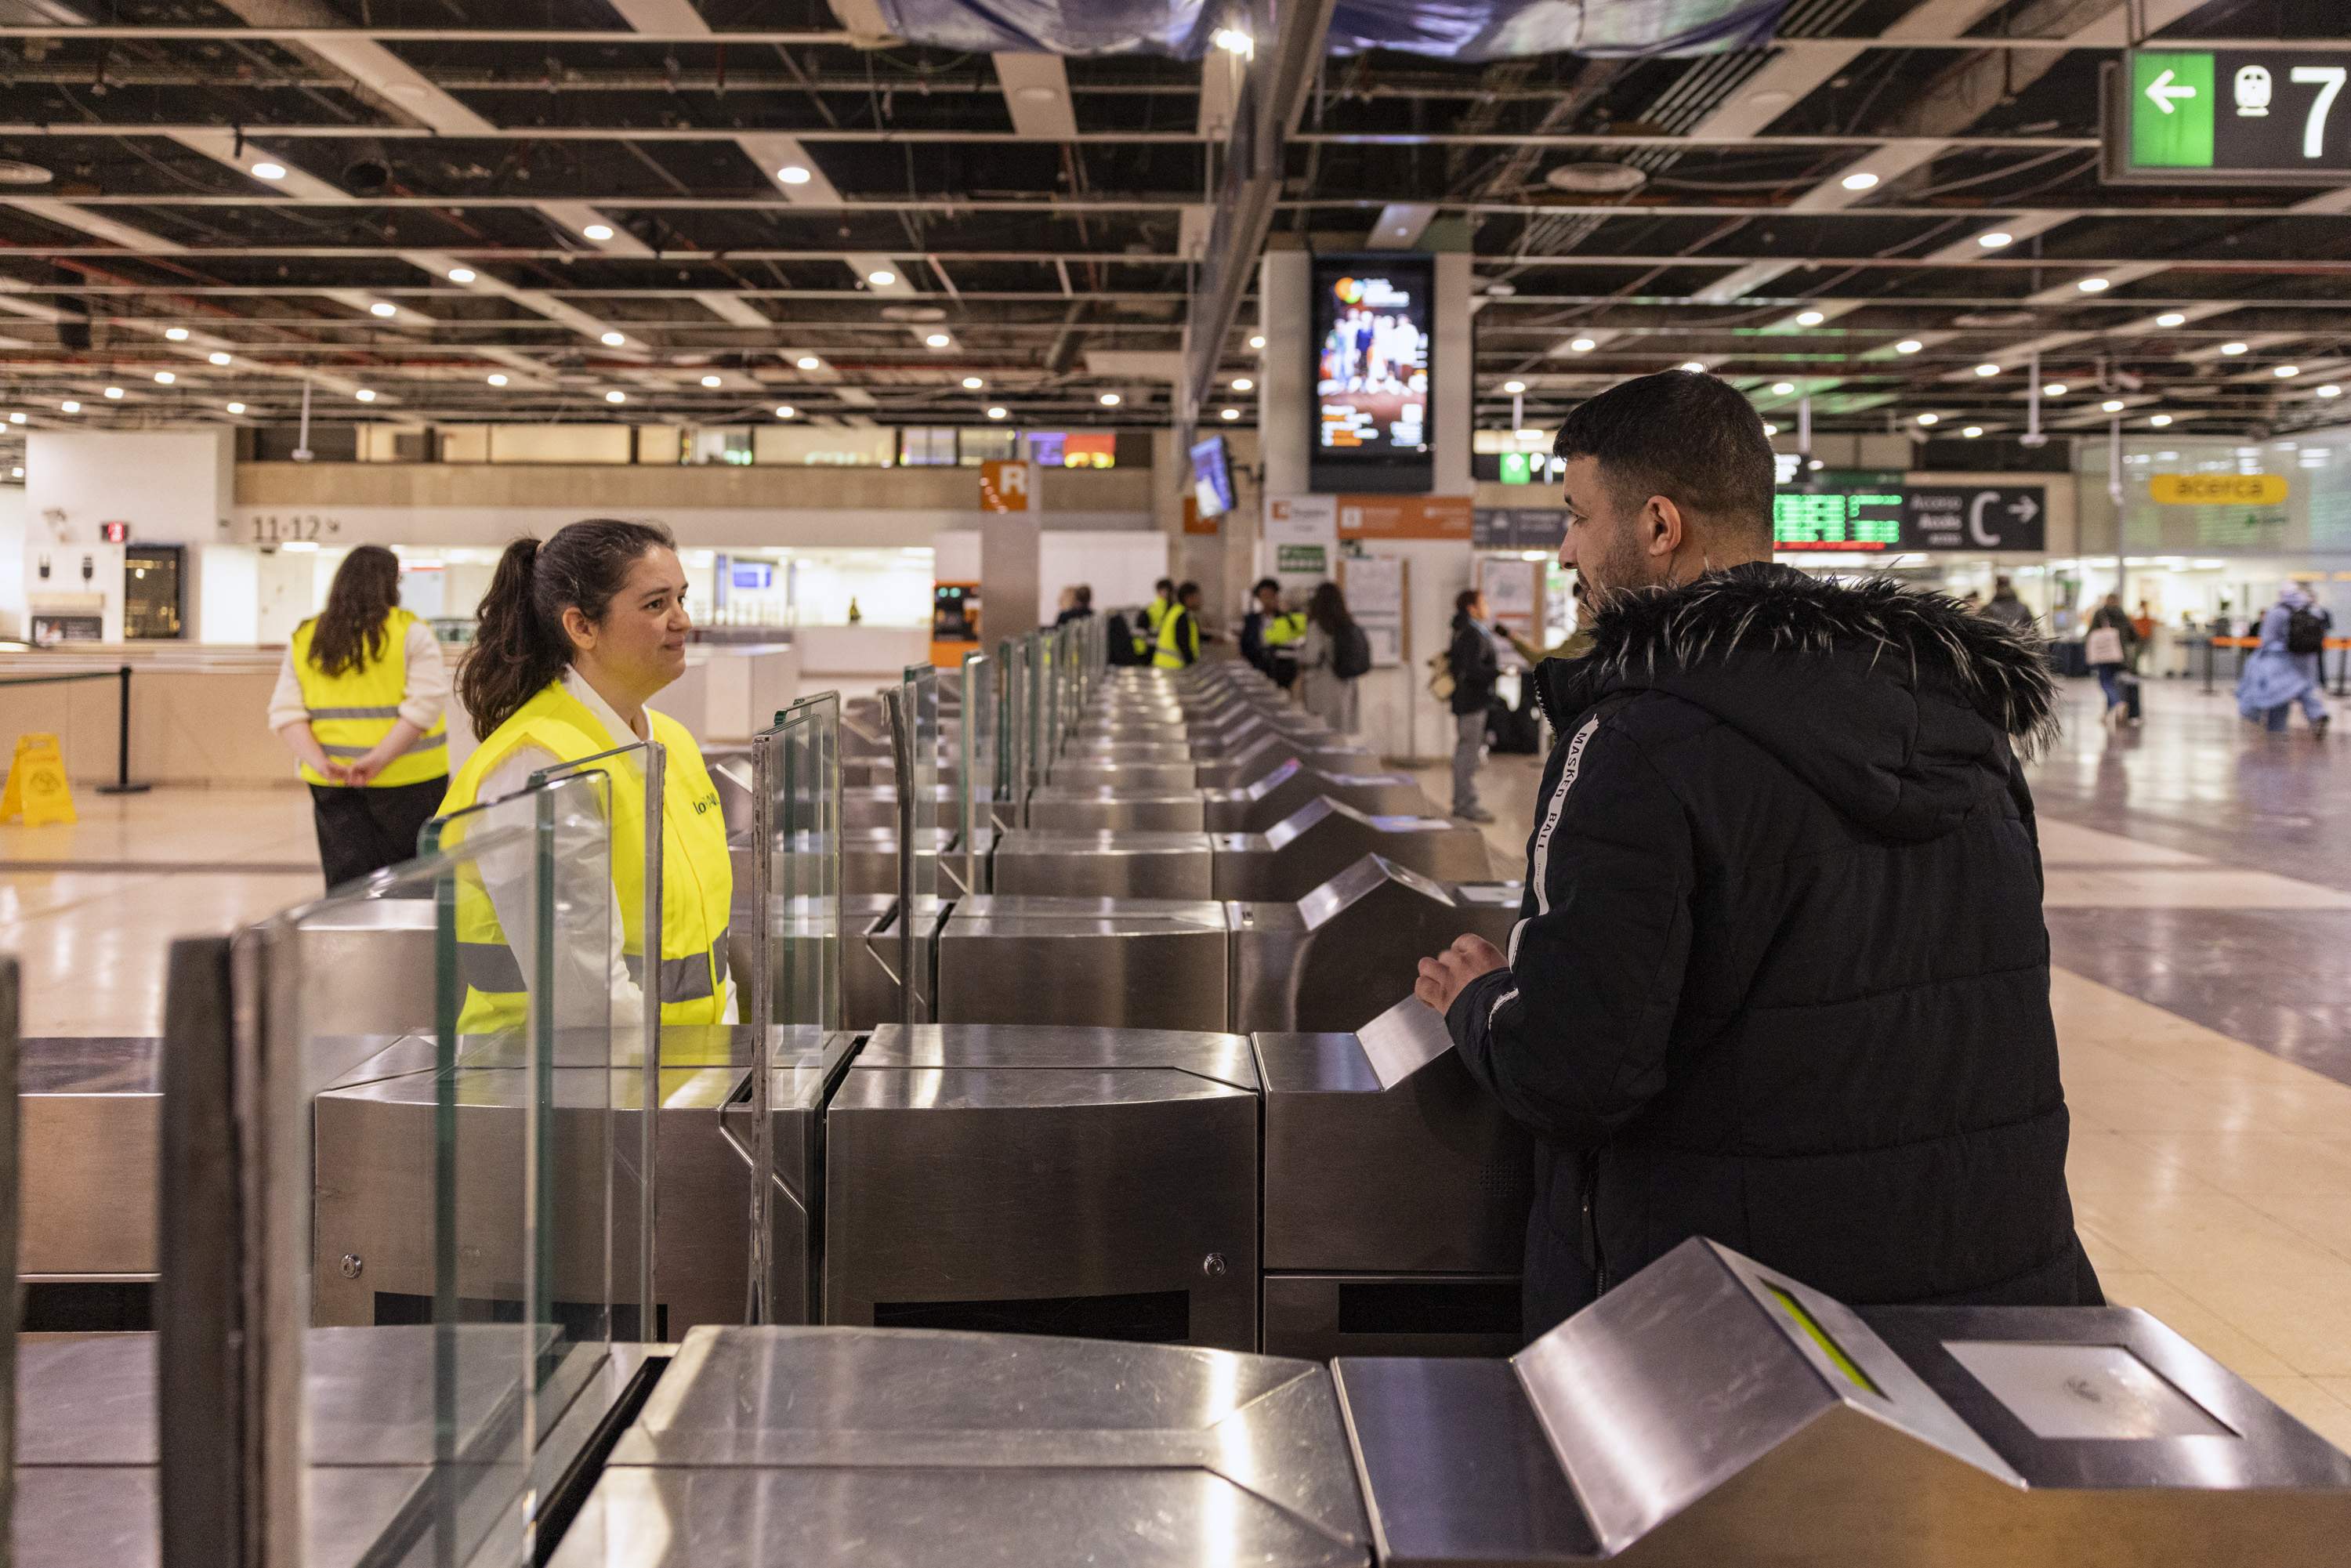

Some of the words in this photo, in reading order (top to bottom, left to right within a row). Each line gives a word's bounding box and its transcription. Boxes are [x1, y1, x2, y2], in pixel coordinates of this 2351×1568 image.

[2290, 66, 2347, 159] 7
[1000, 464, 1029, 494] R
[1969, 491, 2001, 546] C
[1536, 812, 1557, 853] BALL
